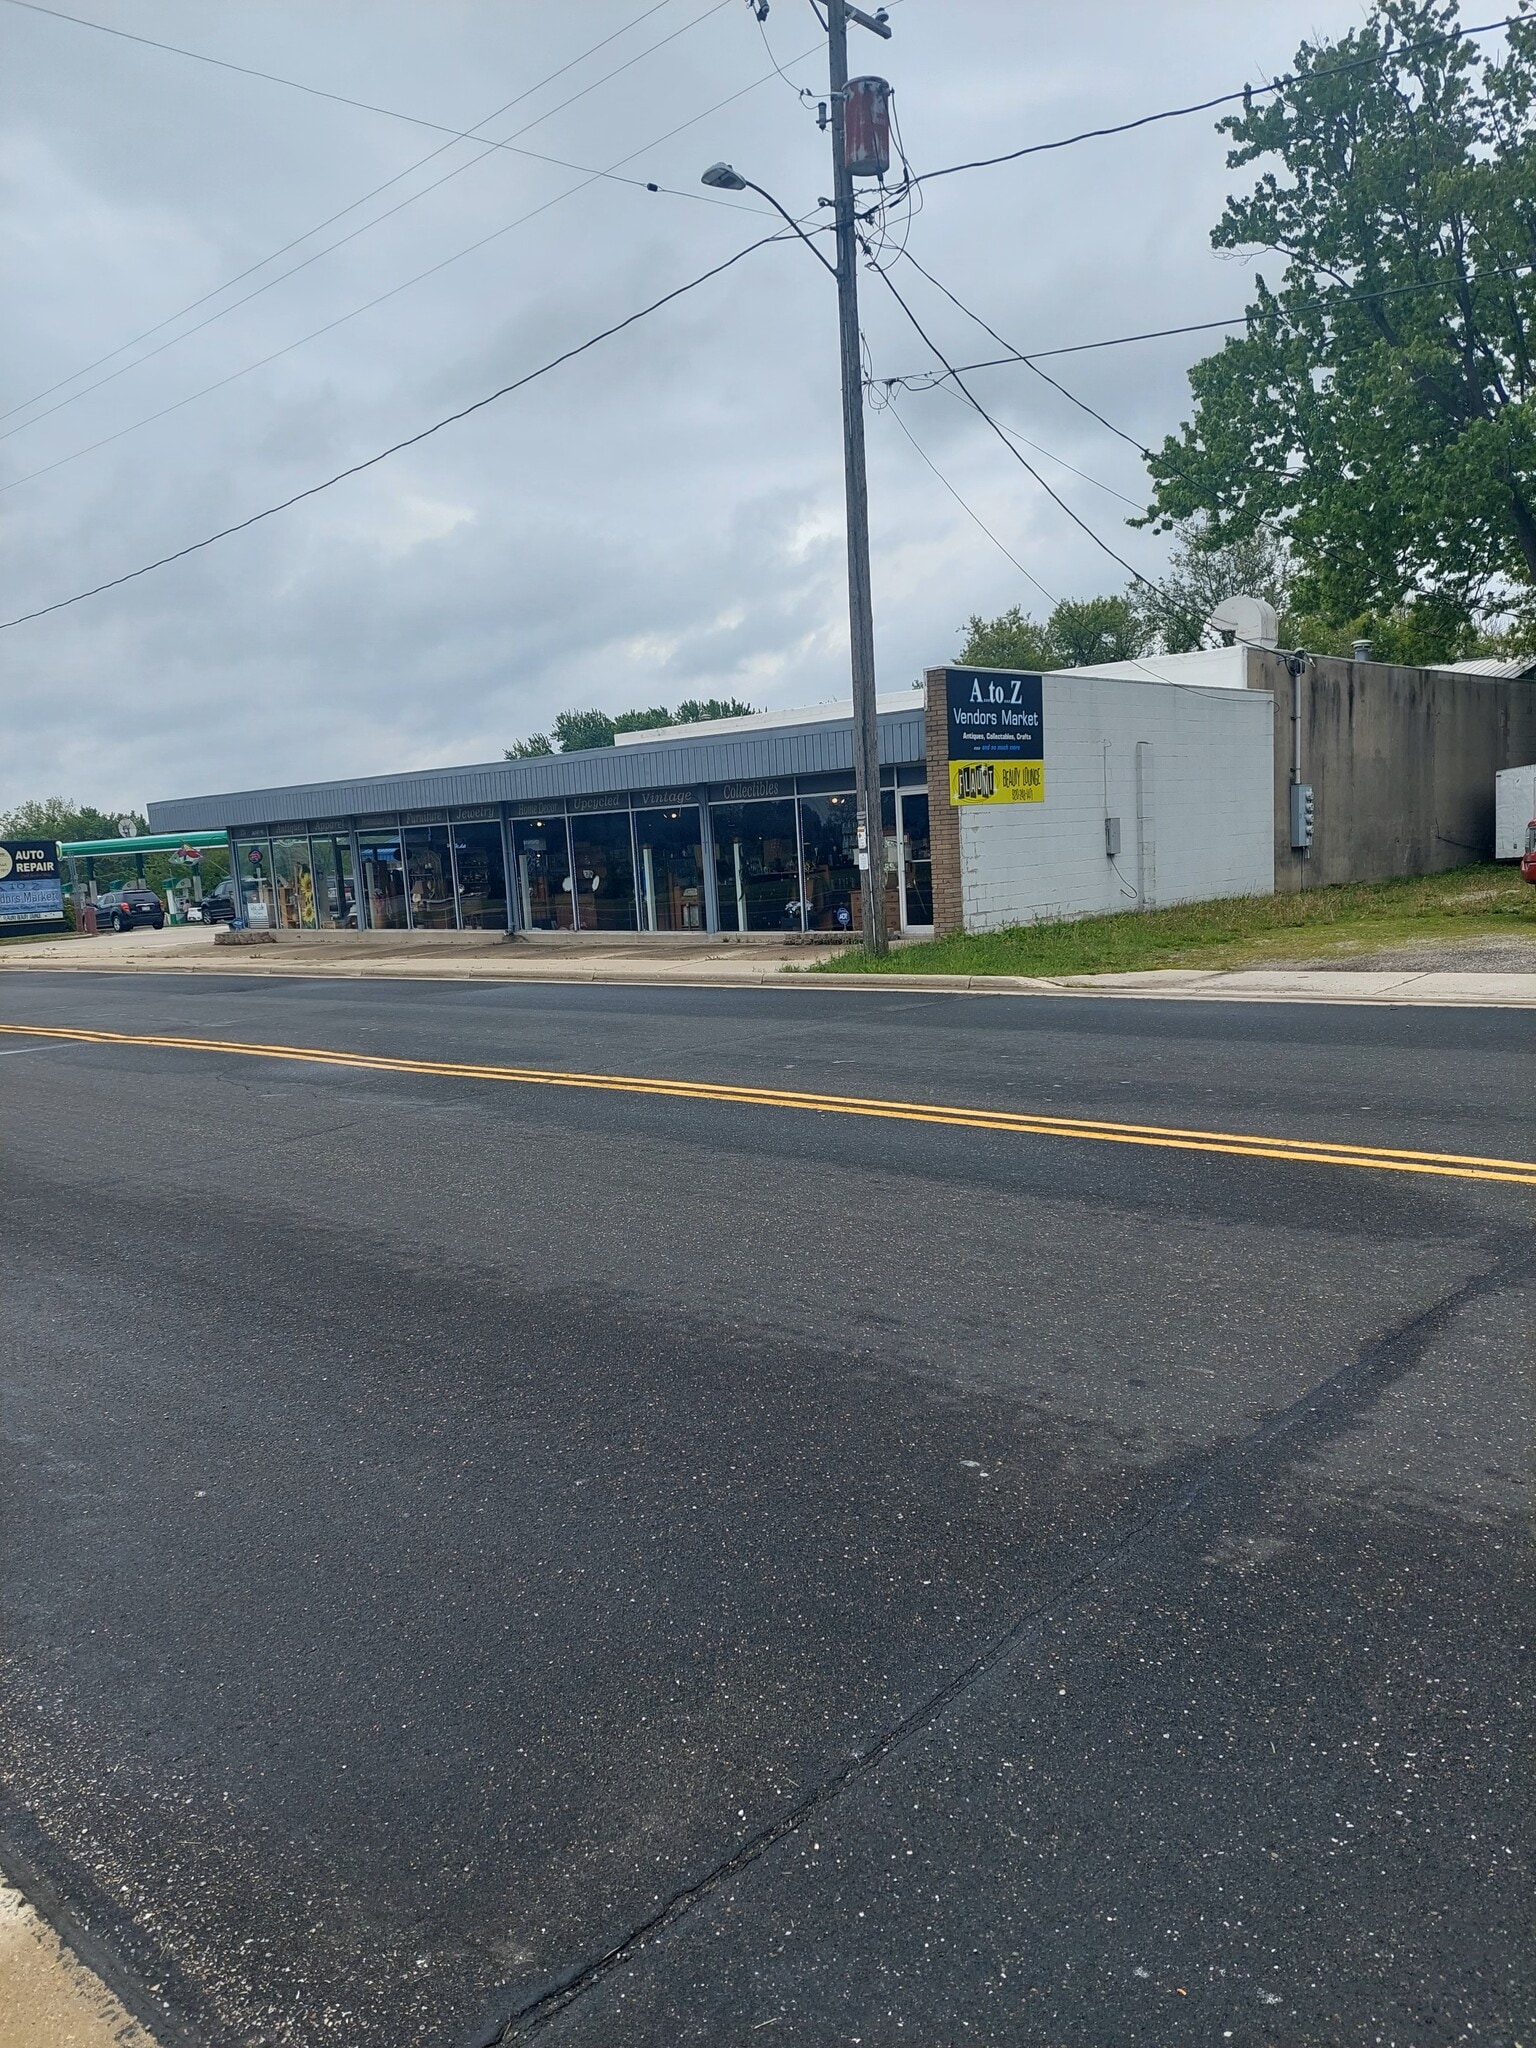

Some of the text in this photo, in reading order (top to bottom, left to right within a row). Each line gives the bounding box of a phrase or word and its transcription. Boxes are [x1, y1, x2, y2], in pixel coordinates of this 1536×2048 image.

[953, 707, 1039, 727] Vendors Market
[962, 731, 986, 741] Antiques,
[1016, 733, 1032, 741] Crafts
[958, 765, 994, 800] FLAUNT
[1002, 766, 1041, 788] BEAUTY LOUNGE
[723, 780, 780, 800] Collectibles
[573, 795, 620, 811] Upcycled
[642, 791, 693, 804] Vintage
[456, 806, 495, 819] Jewelry
[518, 803, 558, 816] Home Decor
[406, 811, 442, 825] Furniture
[276, 822, 305, 835] Antiques
[314, 819, 345, 832] Apparel
[15, 850, 45, 860] AUTO
[16, 862, 55, 873] REPAIR
[23, 891, 57, 903] Market
